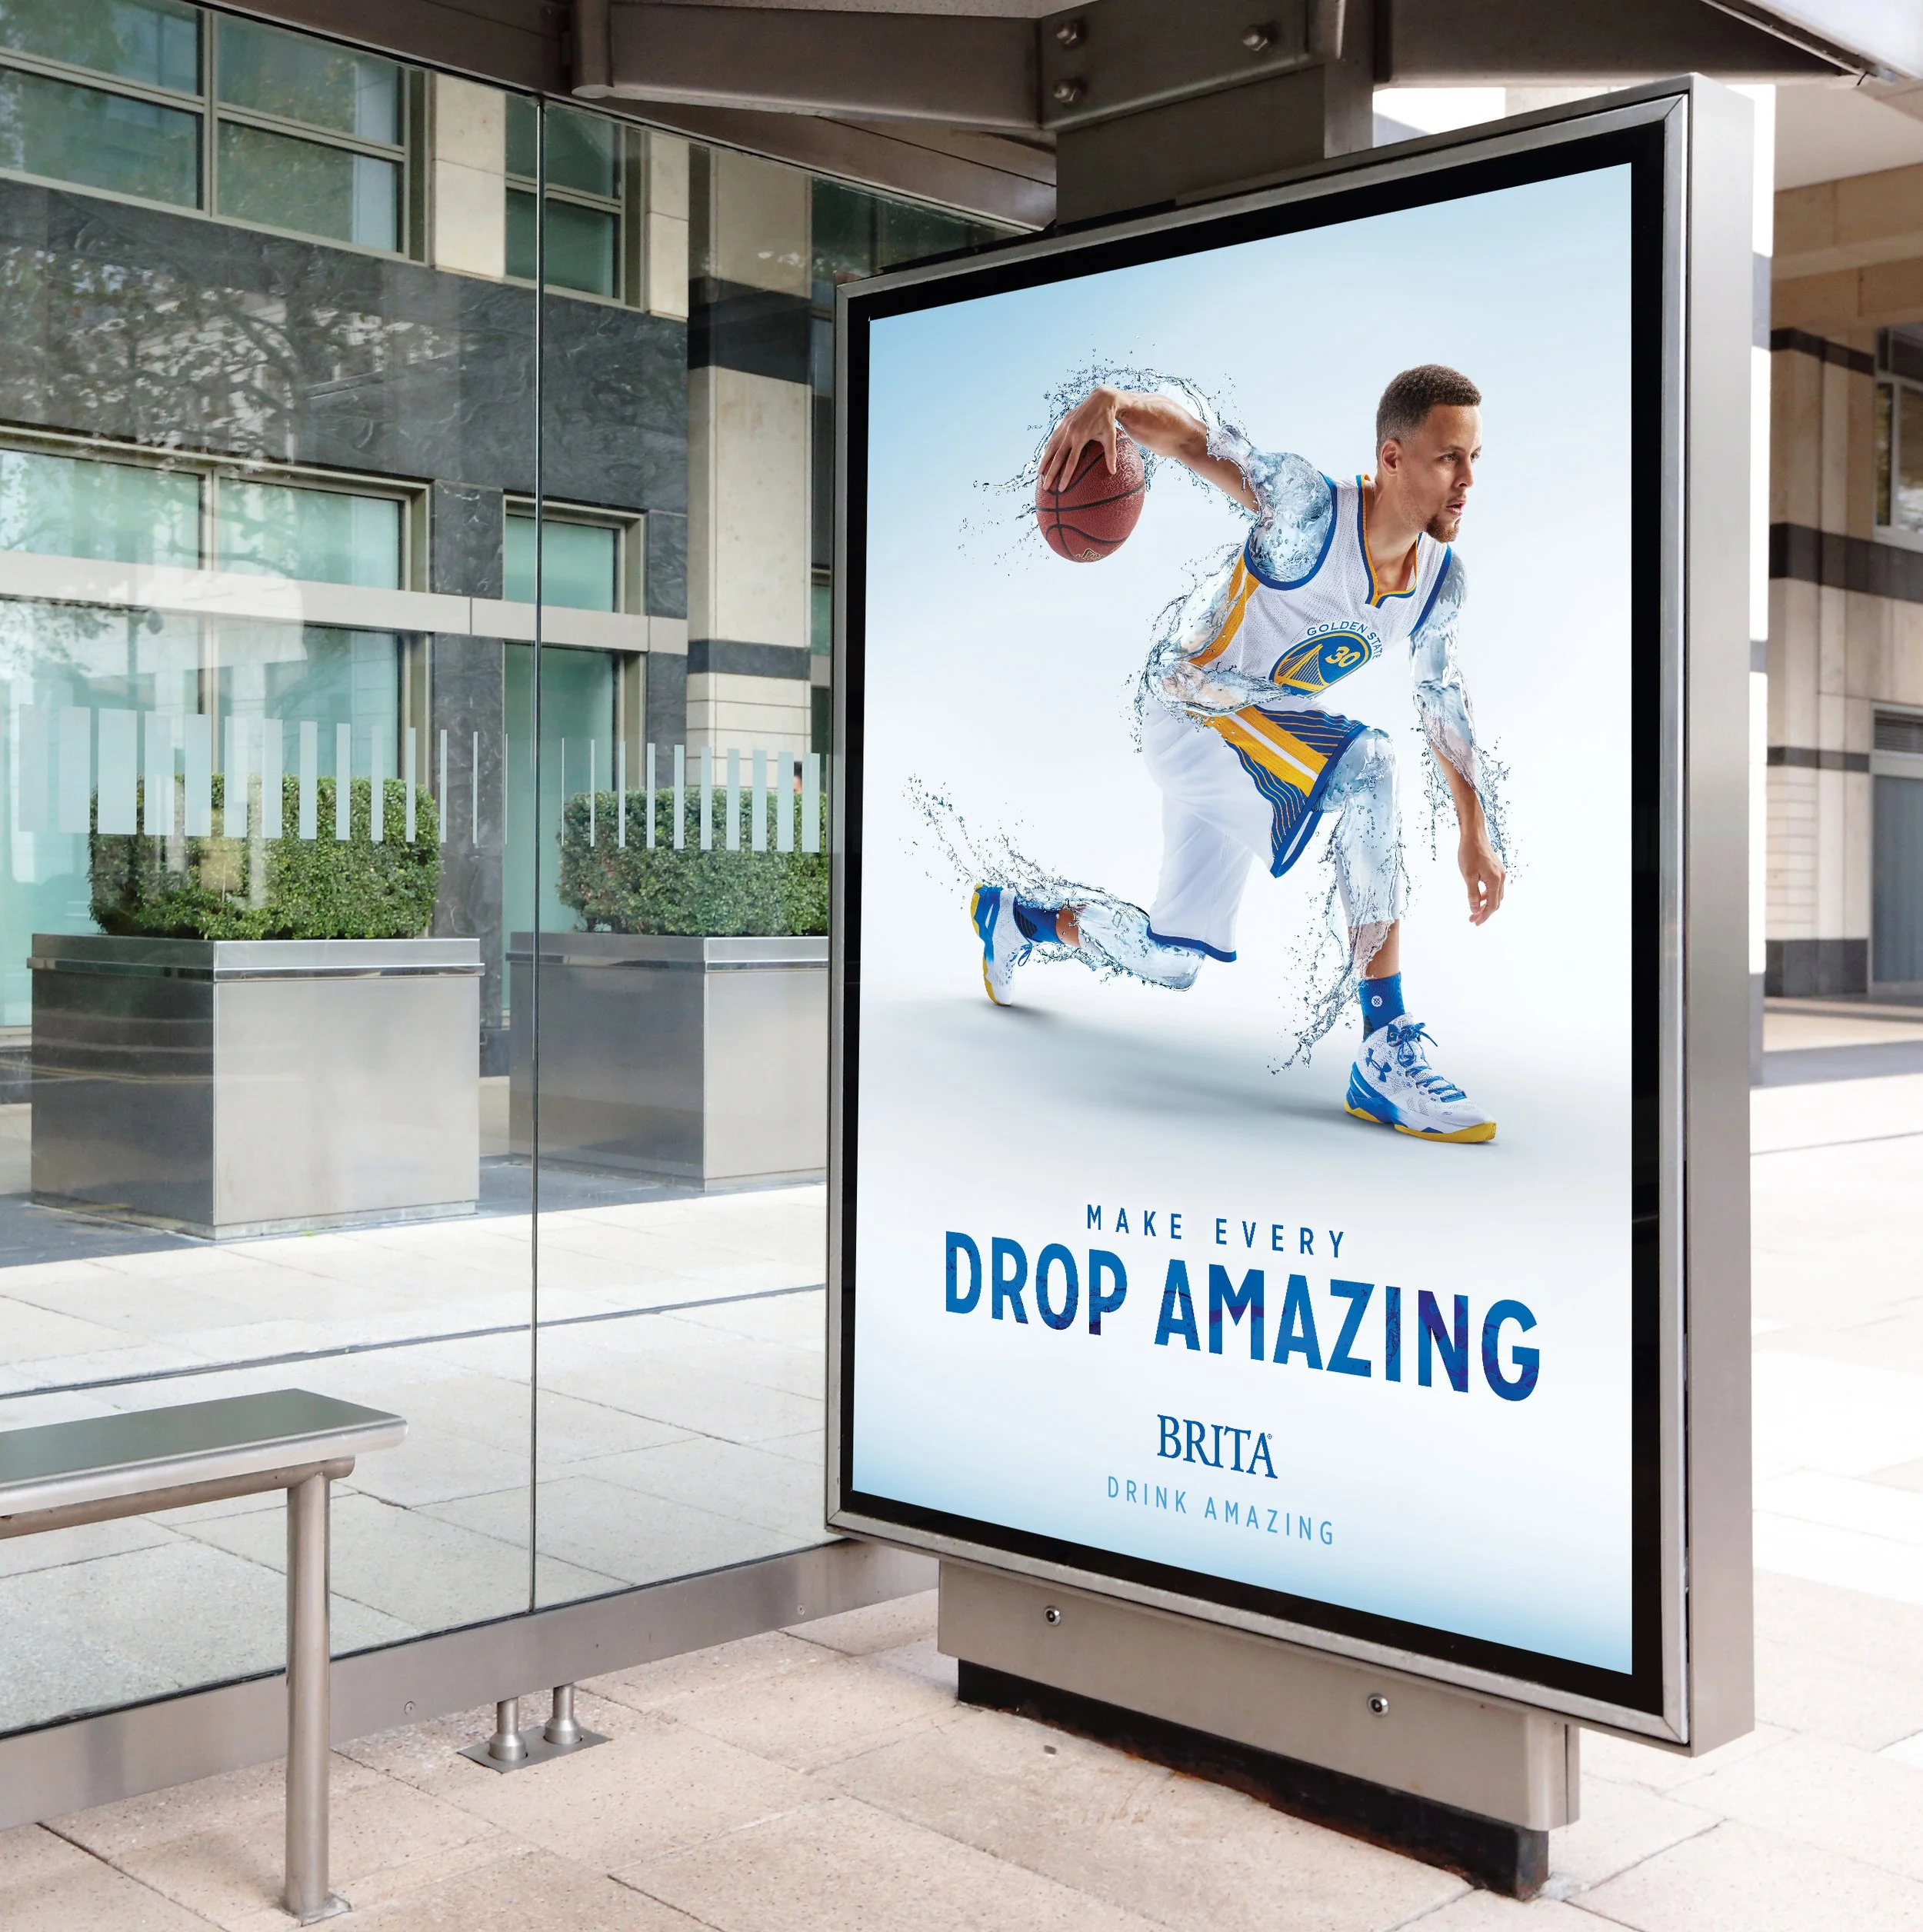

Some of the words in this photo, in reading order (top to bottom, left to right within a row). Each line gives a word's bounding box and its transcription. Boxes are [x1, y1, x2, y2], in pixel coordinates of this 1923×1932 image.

[1306, 621, 1368, 636] GOLDEN
[1366, 631, 1384, 661] STATE
[1325, 645, 1361, 668] 30
[1087, 1204, 1183, 1240] MAKE
[1215, 1217, 1345, 1259] EVERY
[945, 1230, 1128, 1336] DROP
[1154, 1258, 1541, 1402] AMAZING
[1156, 1414, 1278, 1480] BRITA
[1108, 1475, 1188, 1514] DRINK
[1204, 1497, 1334, 1546] AMAZING
